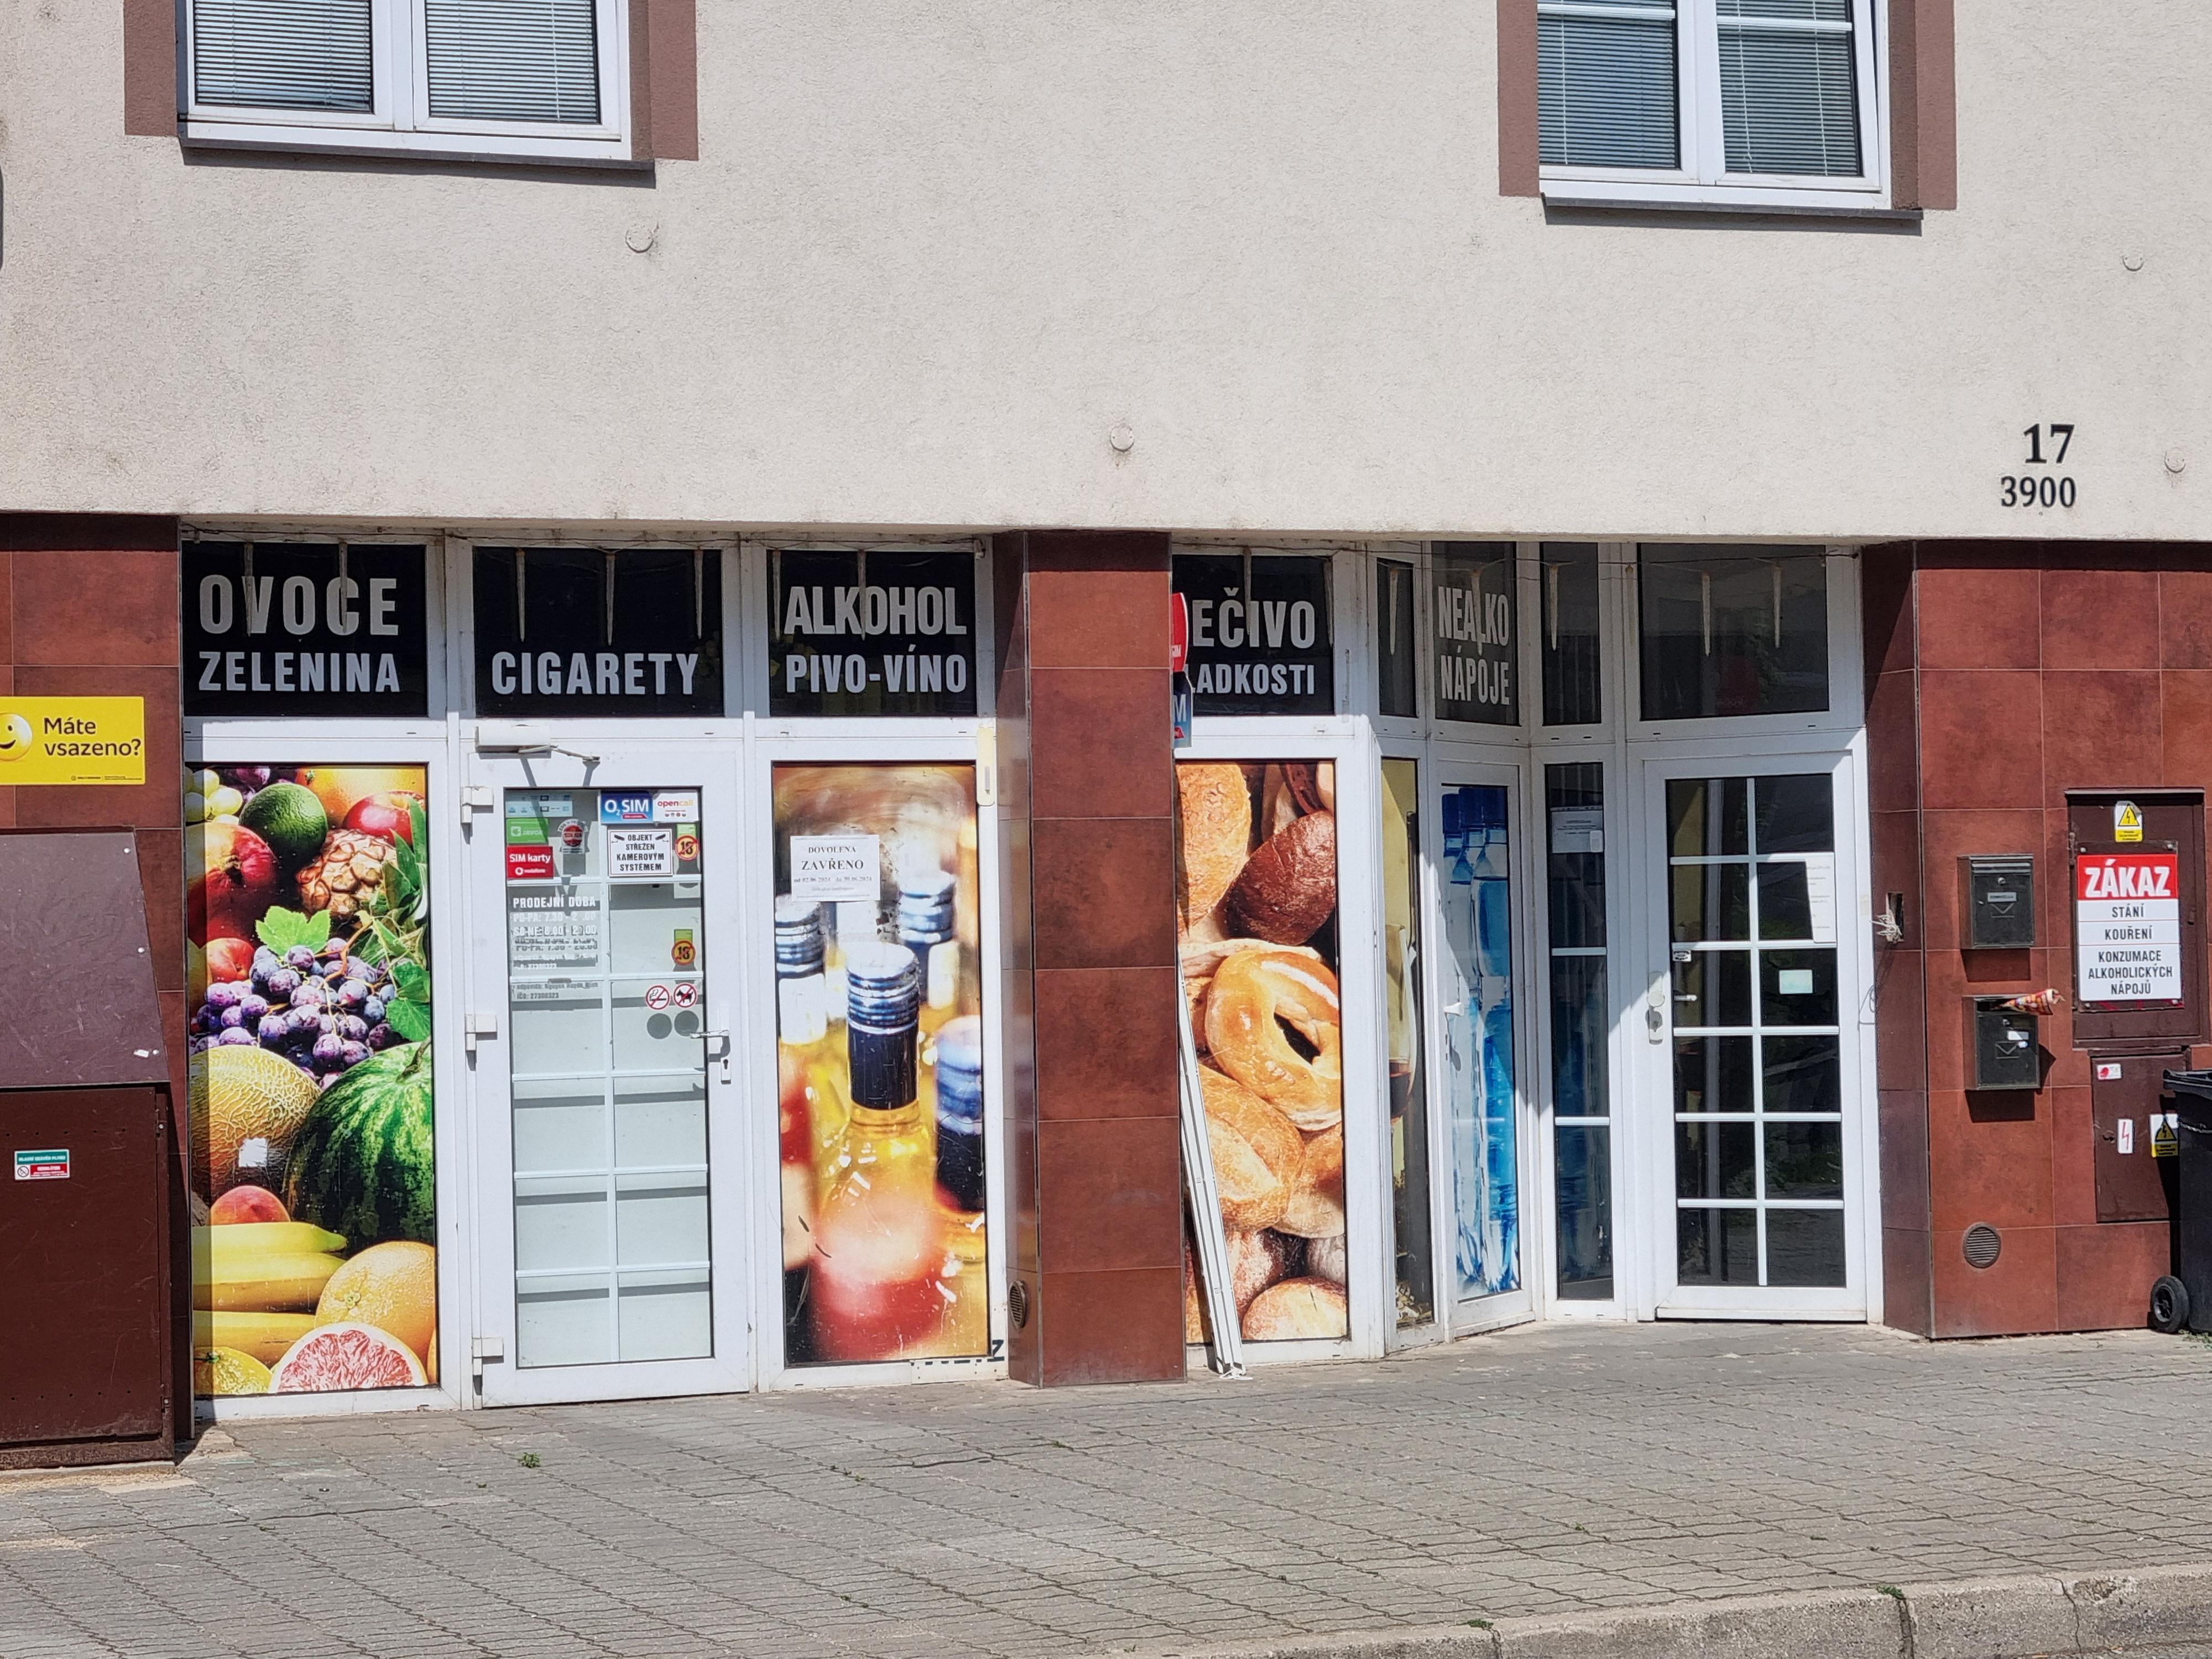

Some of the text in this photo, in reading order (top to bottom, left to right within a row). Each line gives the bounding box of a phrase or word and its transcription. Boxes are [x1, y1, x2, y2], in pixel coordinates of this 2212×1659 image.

[2023, 424, 2075, 464] 17
[2000, 476, 2077, 508] 3900
[199, 575, 399, 636] OVOCE
[784, 586, 967, 635] ALKOHOL
[1192, 587, 1315, 649] EČIVO
[1438, 585, 1509, 646] NEALKO
[199, 651, 400, 692] ZELENINA
[492, 652, 698, 695] CIGARETY
[786, 644, 967, 693] PIVO-VÍNO
[1441, 645, 1510, 705] NÁPOJE
[1190, 664, 1314, 695] ADKOSTI
[44, 717, 96, 735] Máte
[44, 739, 141, 756] vsazeno?
[622, 799, 649, 812] SIM
[658, 800, 693, 808] opencall
[681, 841, 693, 855] 18
[509, 854, 551, 864] SIM karty
[620, 863, 661, 871] SYSTÉMEM
[801, 858, 864, 870] ZAVŘENO
[2084, 858, 2171, 898] ZÁKAZ
[513, 894, 596, 908] PRODEJNÍ DOBA
[2111, 903, 2145, 918] STÁNÍ
[2104, 925, 2153, 940] KOUŘENÍ
[678, 946, 690, 959] 18
[2098, 950, 2162, 963] KONZUMACE
[2088, 963, 2173, 979] ALKOHOLICKÝCH
[2111, 979, 2151, 995] NÁPOJŮ
